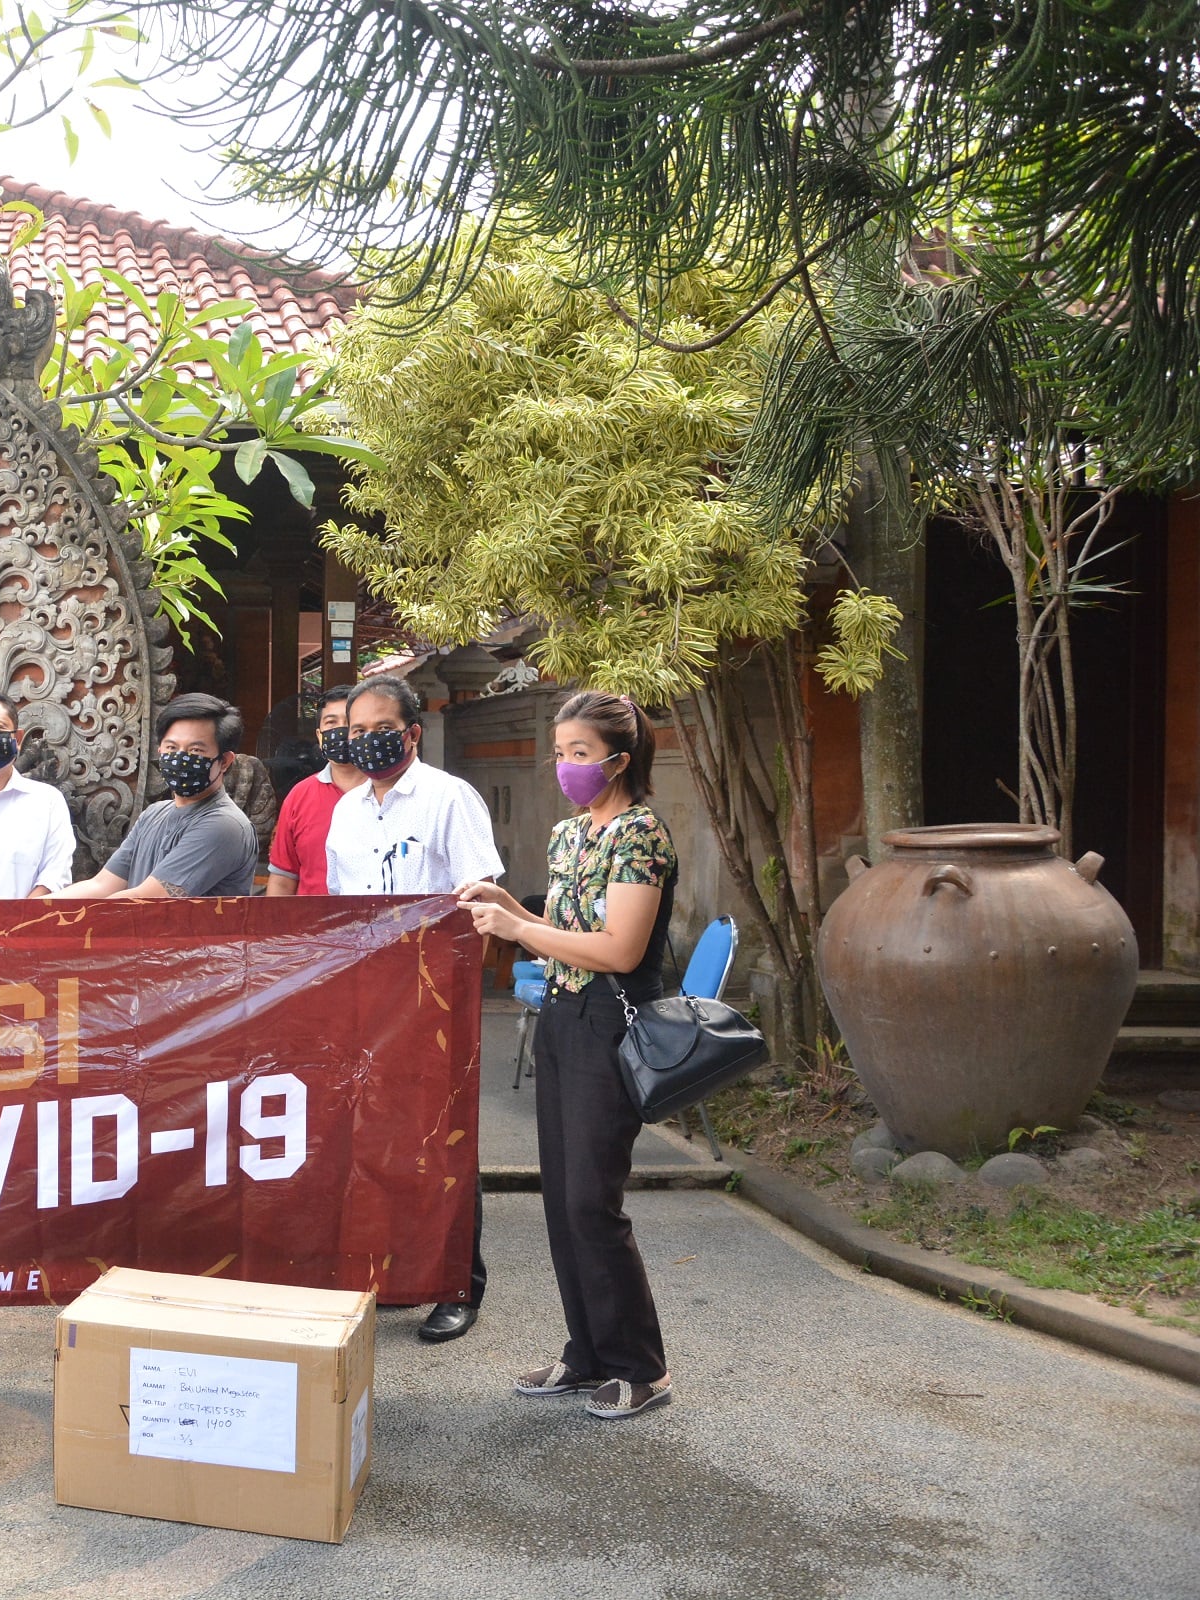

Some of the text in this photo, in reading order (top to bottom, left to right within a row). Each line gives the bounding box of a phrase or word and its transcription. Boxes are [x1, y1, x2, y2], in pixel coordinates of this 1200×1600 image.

[142, 1382, 166, 1390] ALAMAT
[142, 1415, 170, 1424] QUANTITY
[207, 1418, 232, 1429] 1400
